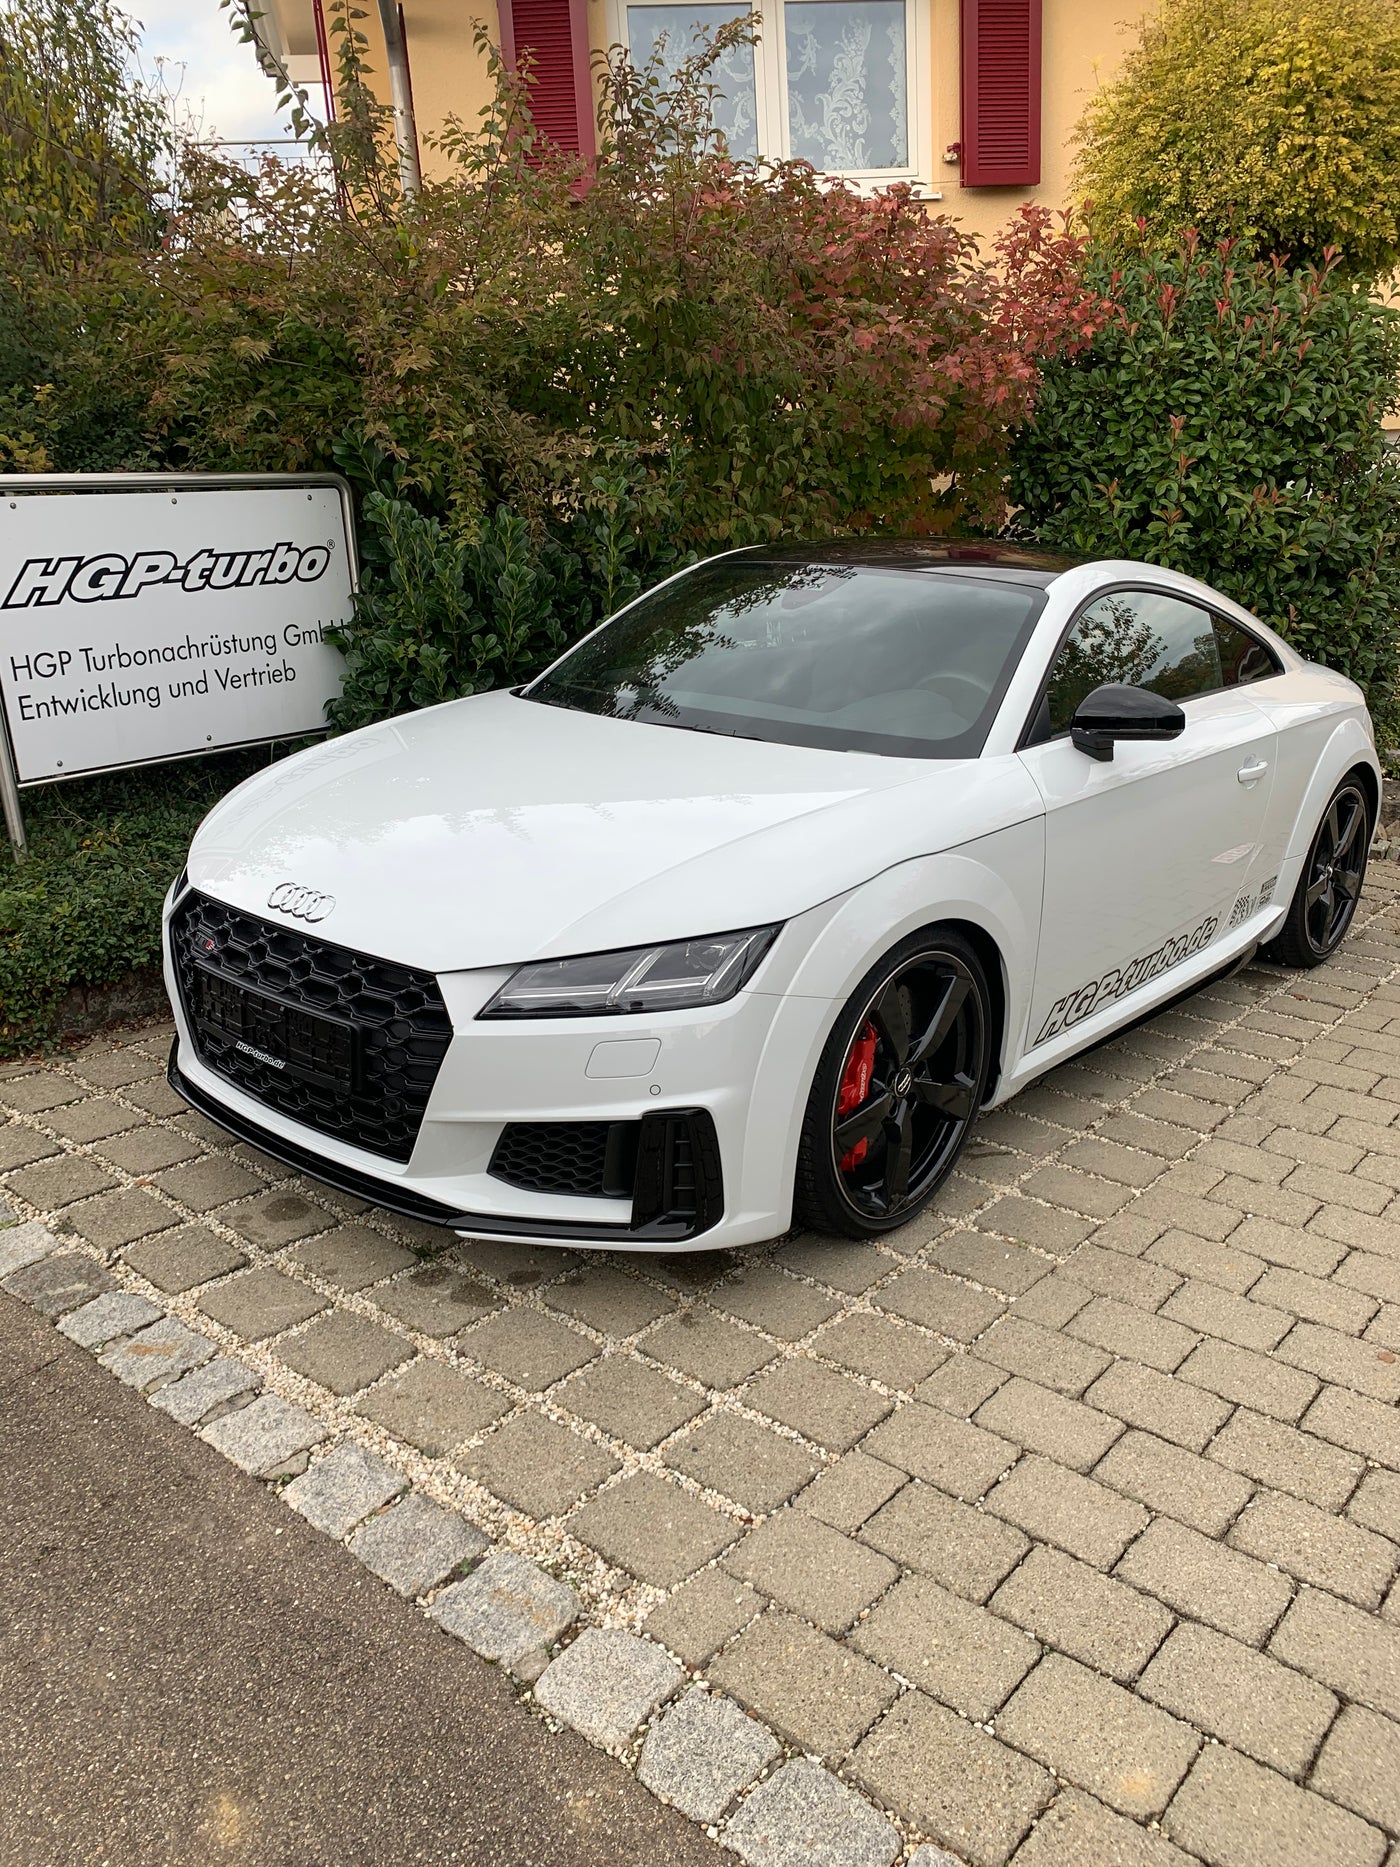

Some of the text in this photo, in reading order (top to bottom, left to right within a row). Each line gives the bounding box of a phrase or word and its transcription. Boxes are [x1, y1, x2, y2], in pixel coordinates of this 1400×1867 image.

[10, 651, 72, 682] HGP
[79, 635, 277, 673] Turbonachrüstung
[18, 659, 297, 721] Entwicklung und Vertrieb
